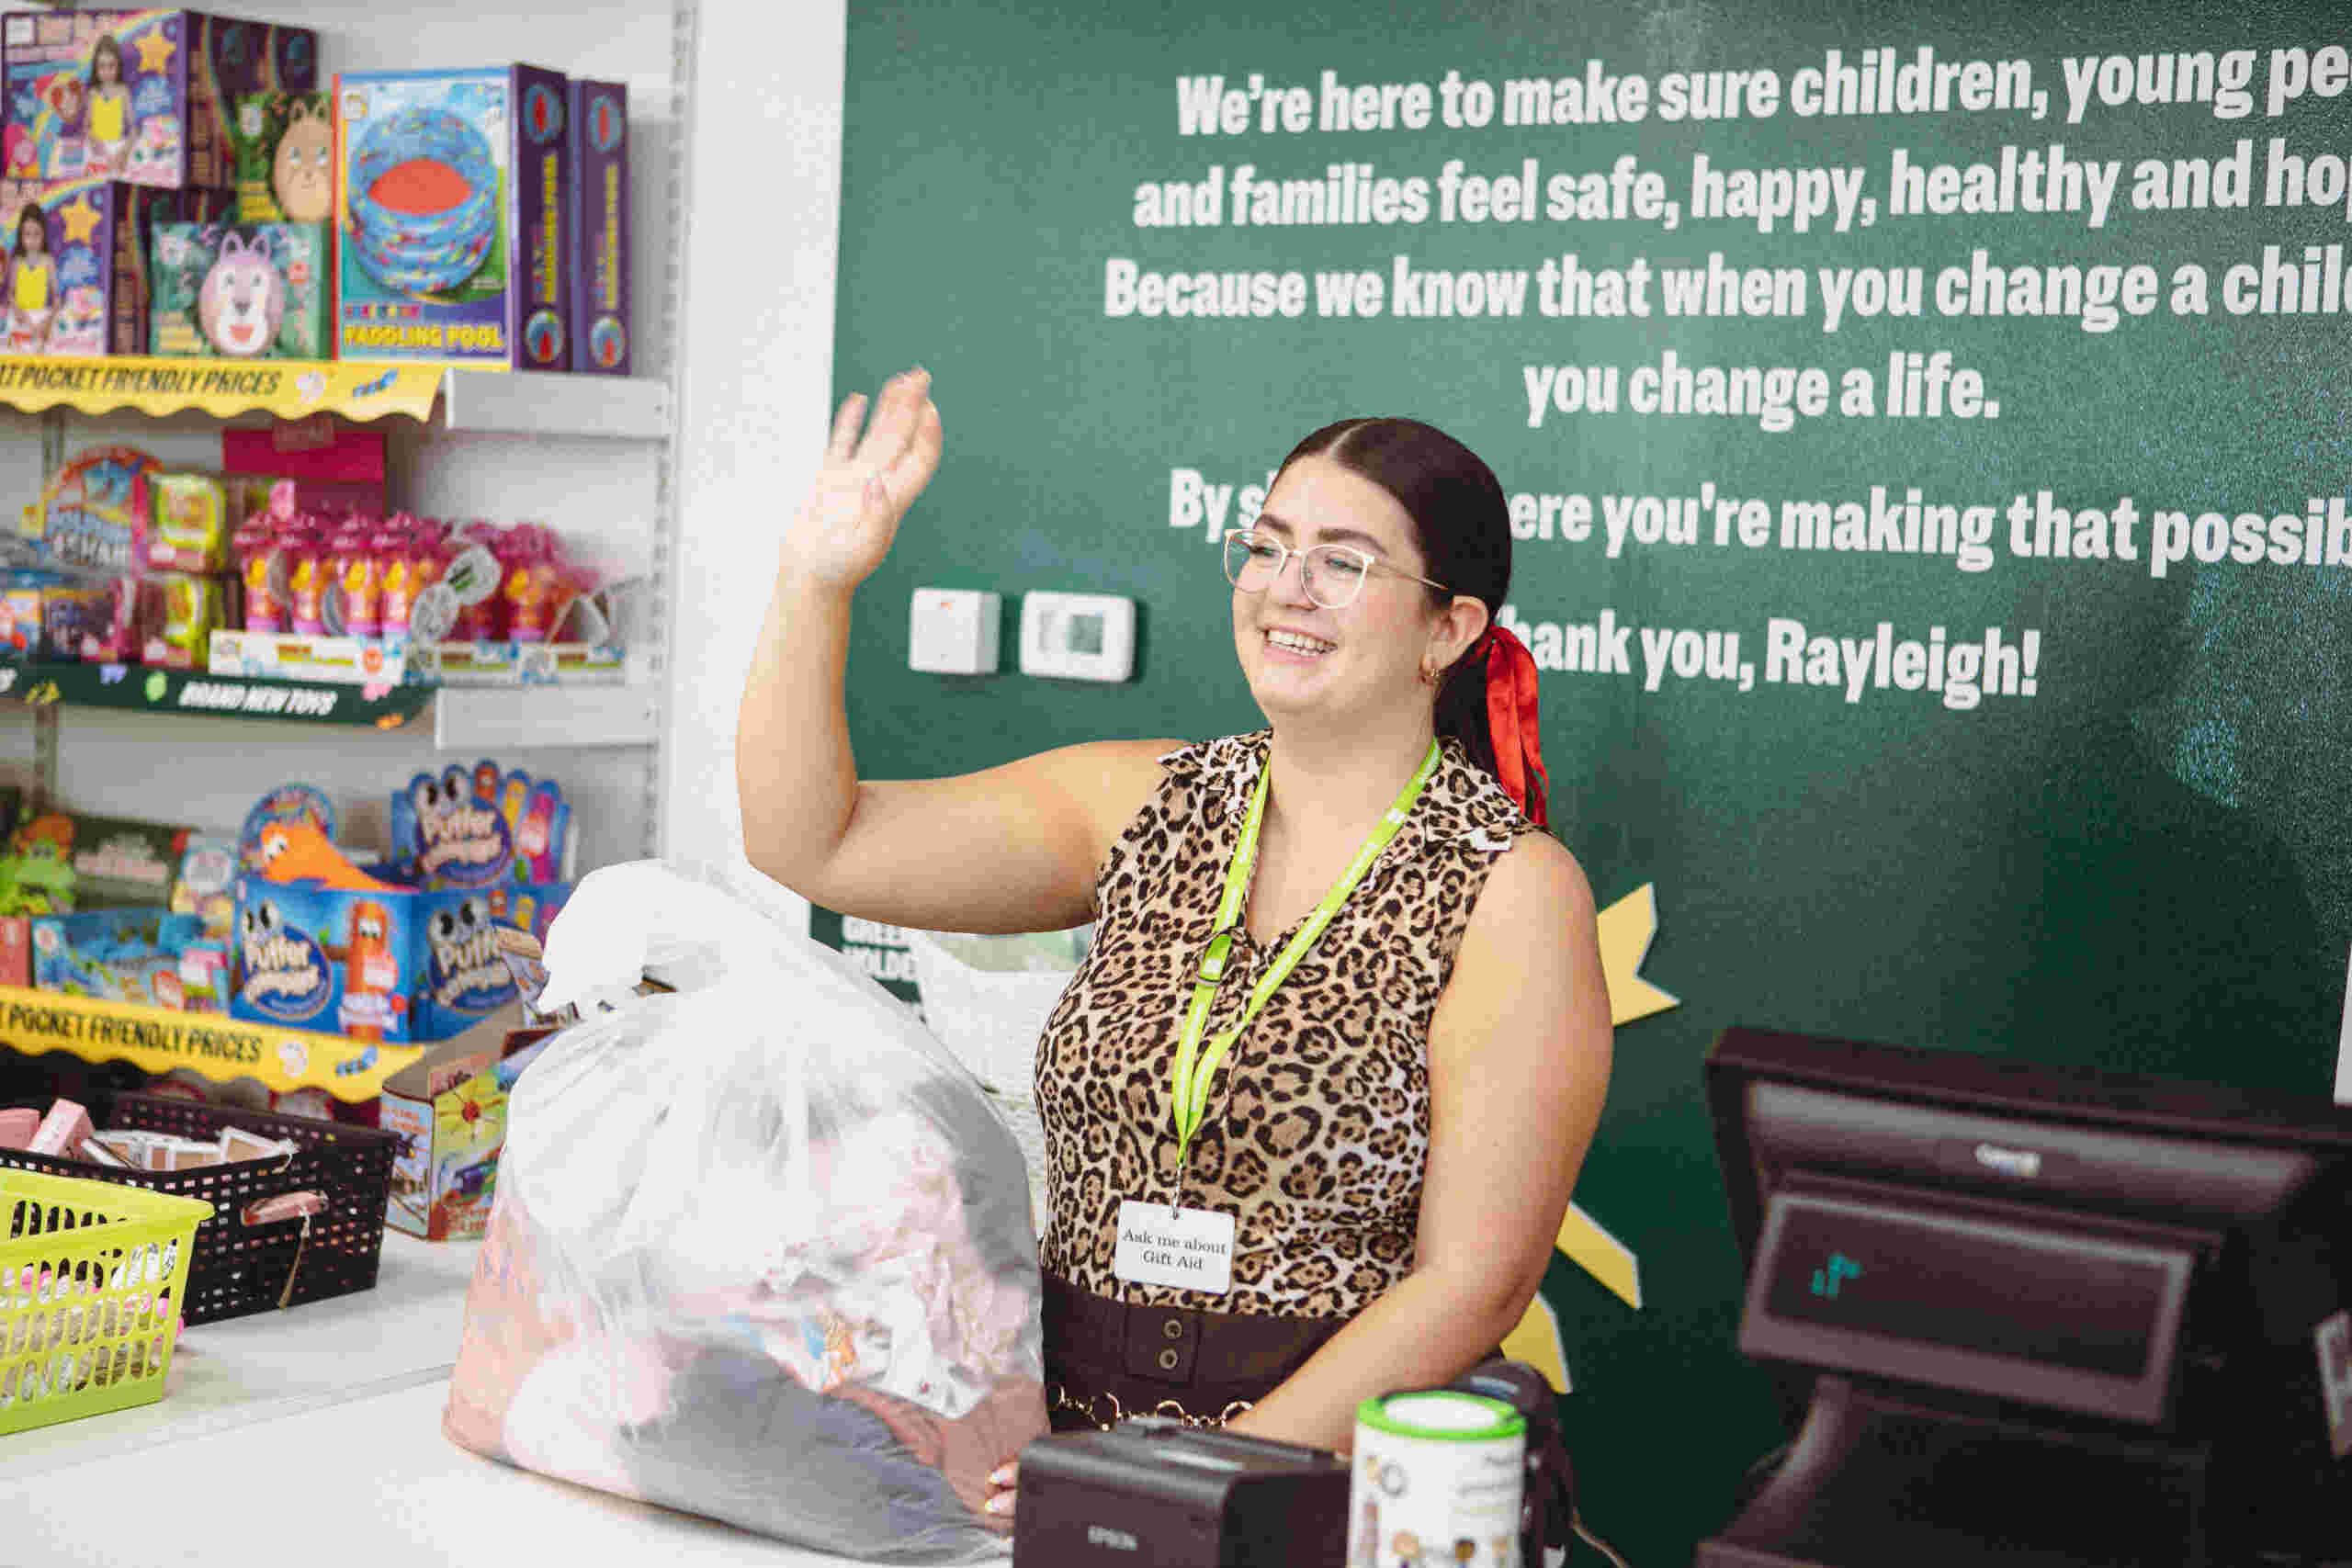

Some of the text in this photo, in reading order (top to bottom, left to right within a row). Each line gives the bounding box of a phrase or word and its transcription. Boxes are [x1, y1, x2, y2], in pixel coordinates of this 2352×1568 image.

[1319, 71, 1431, 131] here
[1440, 71, 1495, 129] to
[1503, 60, 1648, 126] make
[1657, 69, 1780, 121] sure
[1790, 45, 2048, 120] children,
[2062, 46, 2257, 124] young
[2266, 46, 2352, 117] pe
[1133, 137, 2352, 234] and families feel safe, happy, healthy and ho
[1104, 243, 2352, 333] Because we know that when you change a chil
[447, 325, 504, 348] POOL
[20, 365, 102, 389] POCKET
[102, 367, 200, 392] FRIENDLY
[202, 369, 282, 395] PRICES
[1523, 349, 2000, 433] you change a life.
[1169, 468, 1233, 544] By
[1509, 493, 1593, 542] ere
[1600, 481, 1771, 558] you're
[1780, 484, 1997, 572] making
[2007, 491, 2140, 560] that
[1640, 628, 1754, 692] you,
[1765, 616, 2041, 709] Rayleigh!
[241, 686, 292, 713] NEW
[8, 1002, 90, 1038] POCKET
[89, 1015, 182, 1052] FRIENDLY
[187, 1028, 263, 1064] PRICES
[1122, 1228, 1227, 1255] Ask me about
[1142, 1248, 1204, 1269] Gift Aid
